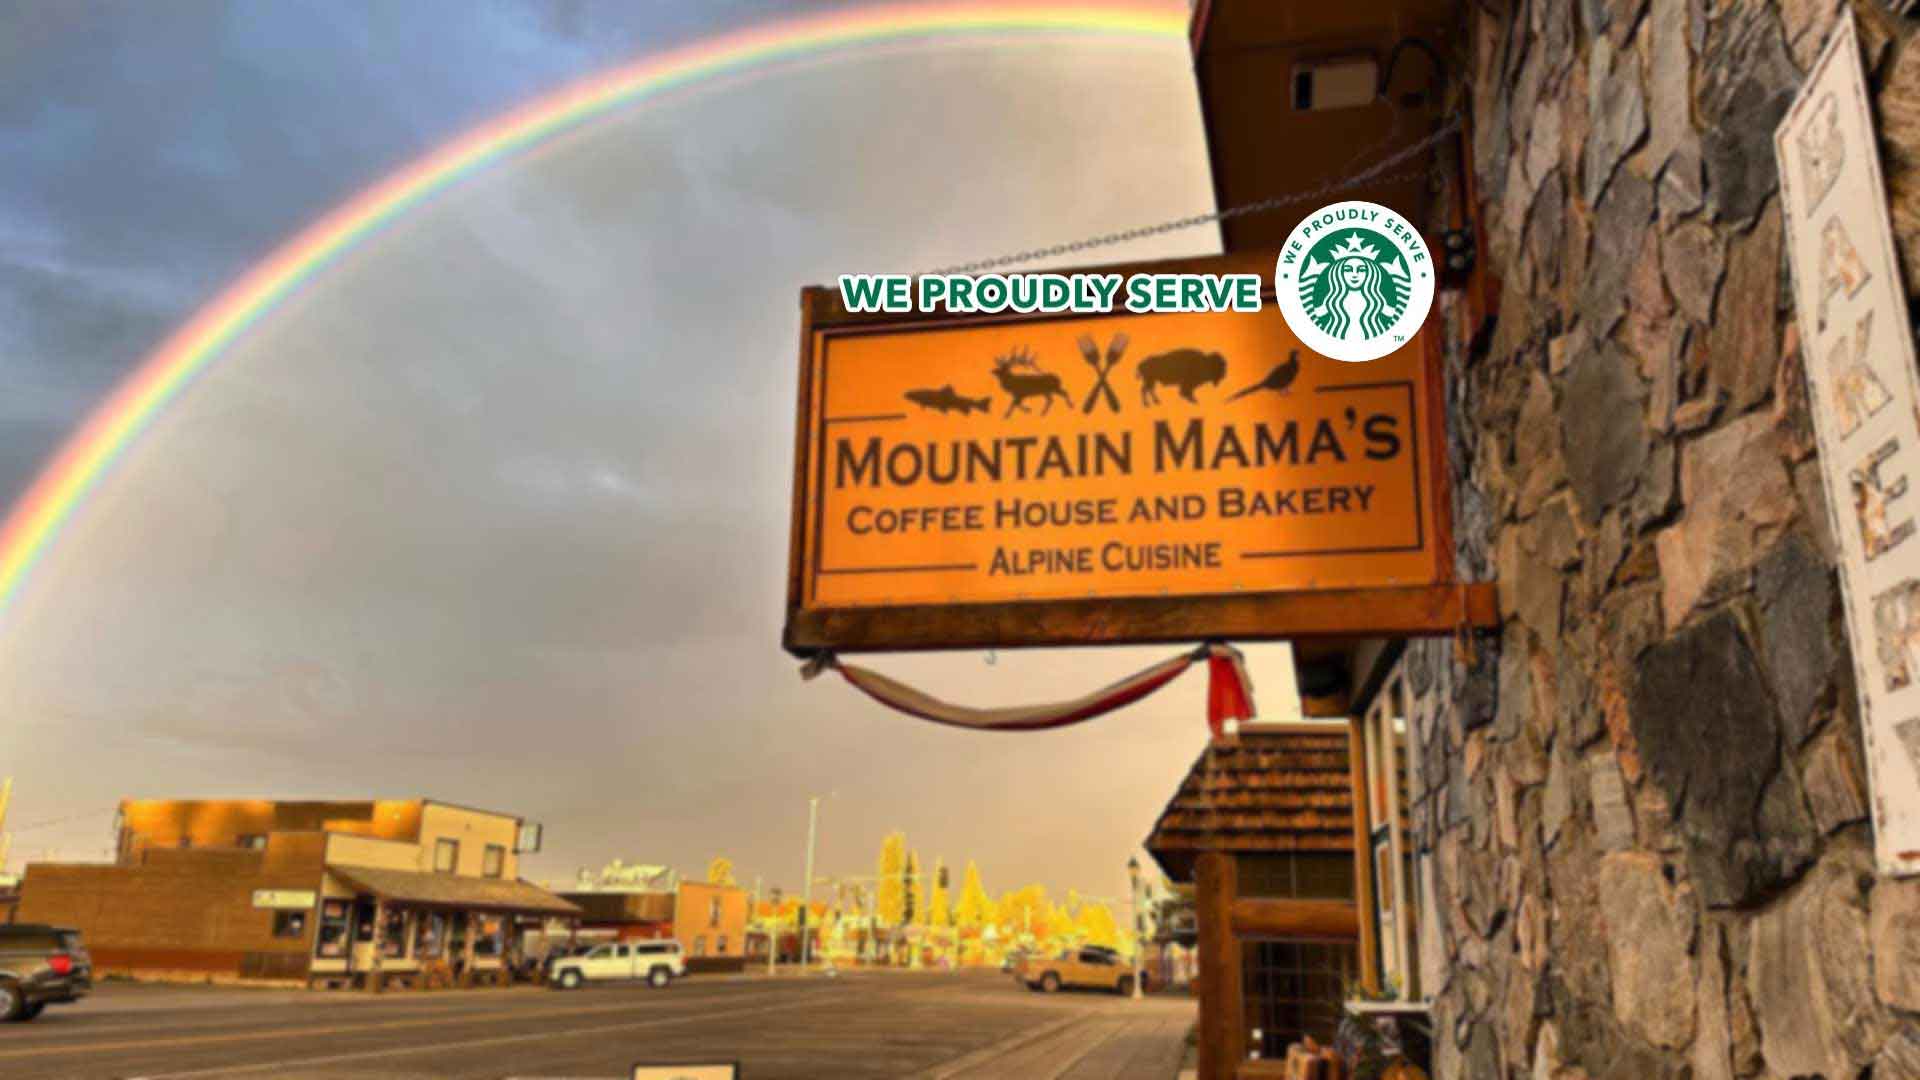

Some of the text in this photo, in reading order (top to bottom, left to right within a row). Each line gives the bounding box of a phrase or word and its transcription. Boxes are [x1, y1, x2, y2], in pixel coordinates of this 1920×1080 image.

[835, 431, 1132, 488] MOUNTAIN
[1797, 90, 1920, 792] BAKER
[846, 484, 1374, 534] COFFEE HOUSE AND BAKERY
[988, 541, 1222, 577] ALPINE CUISINE
